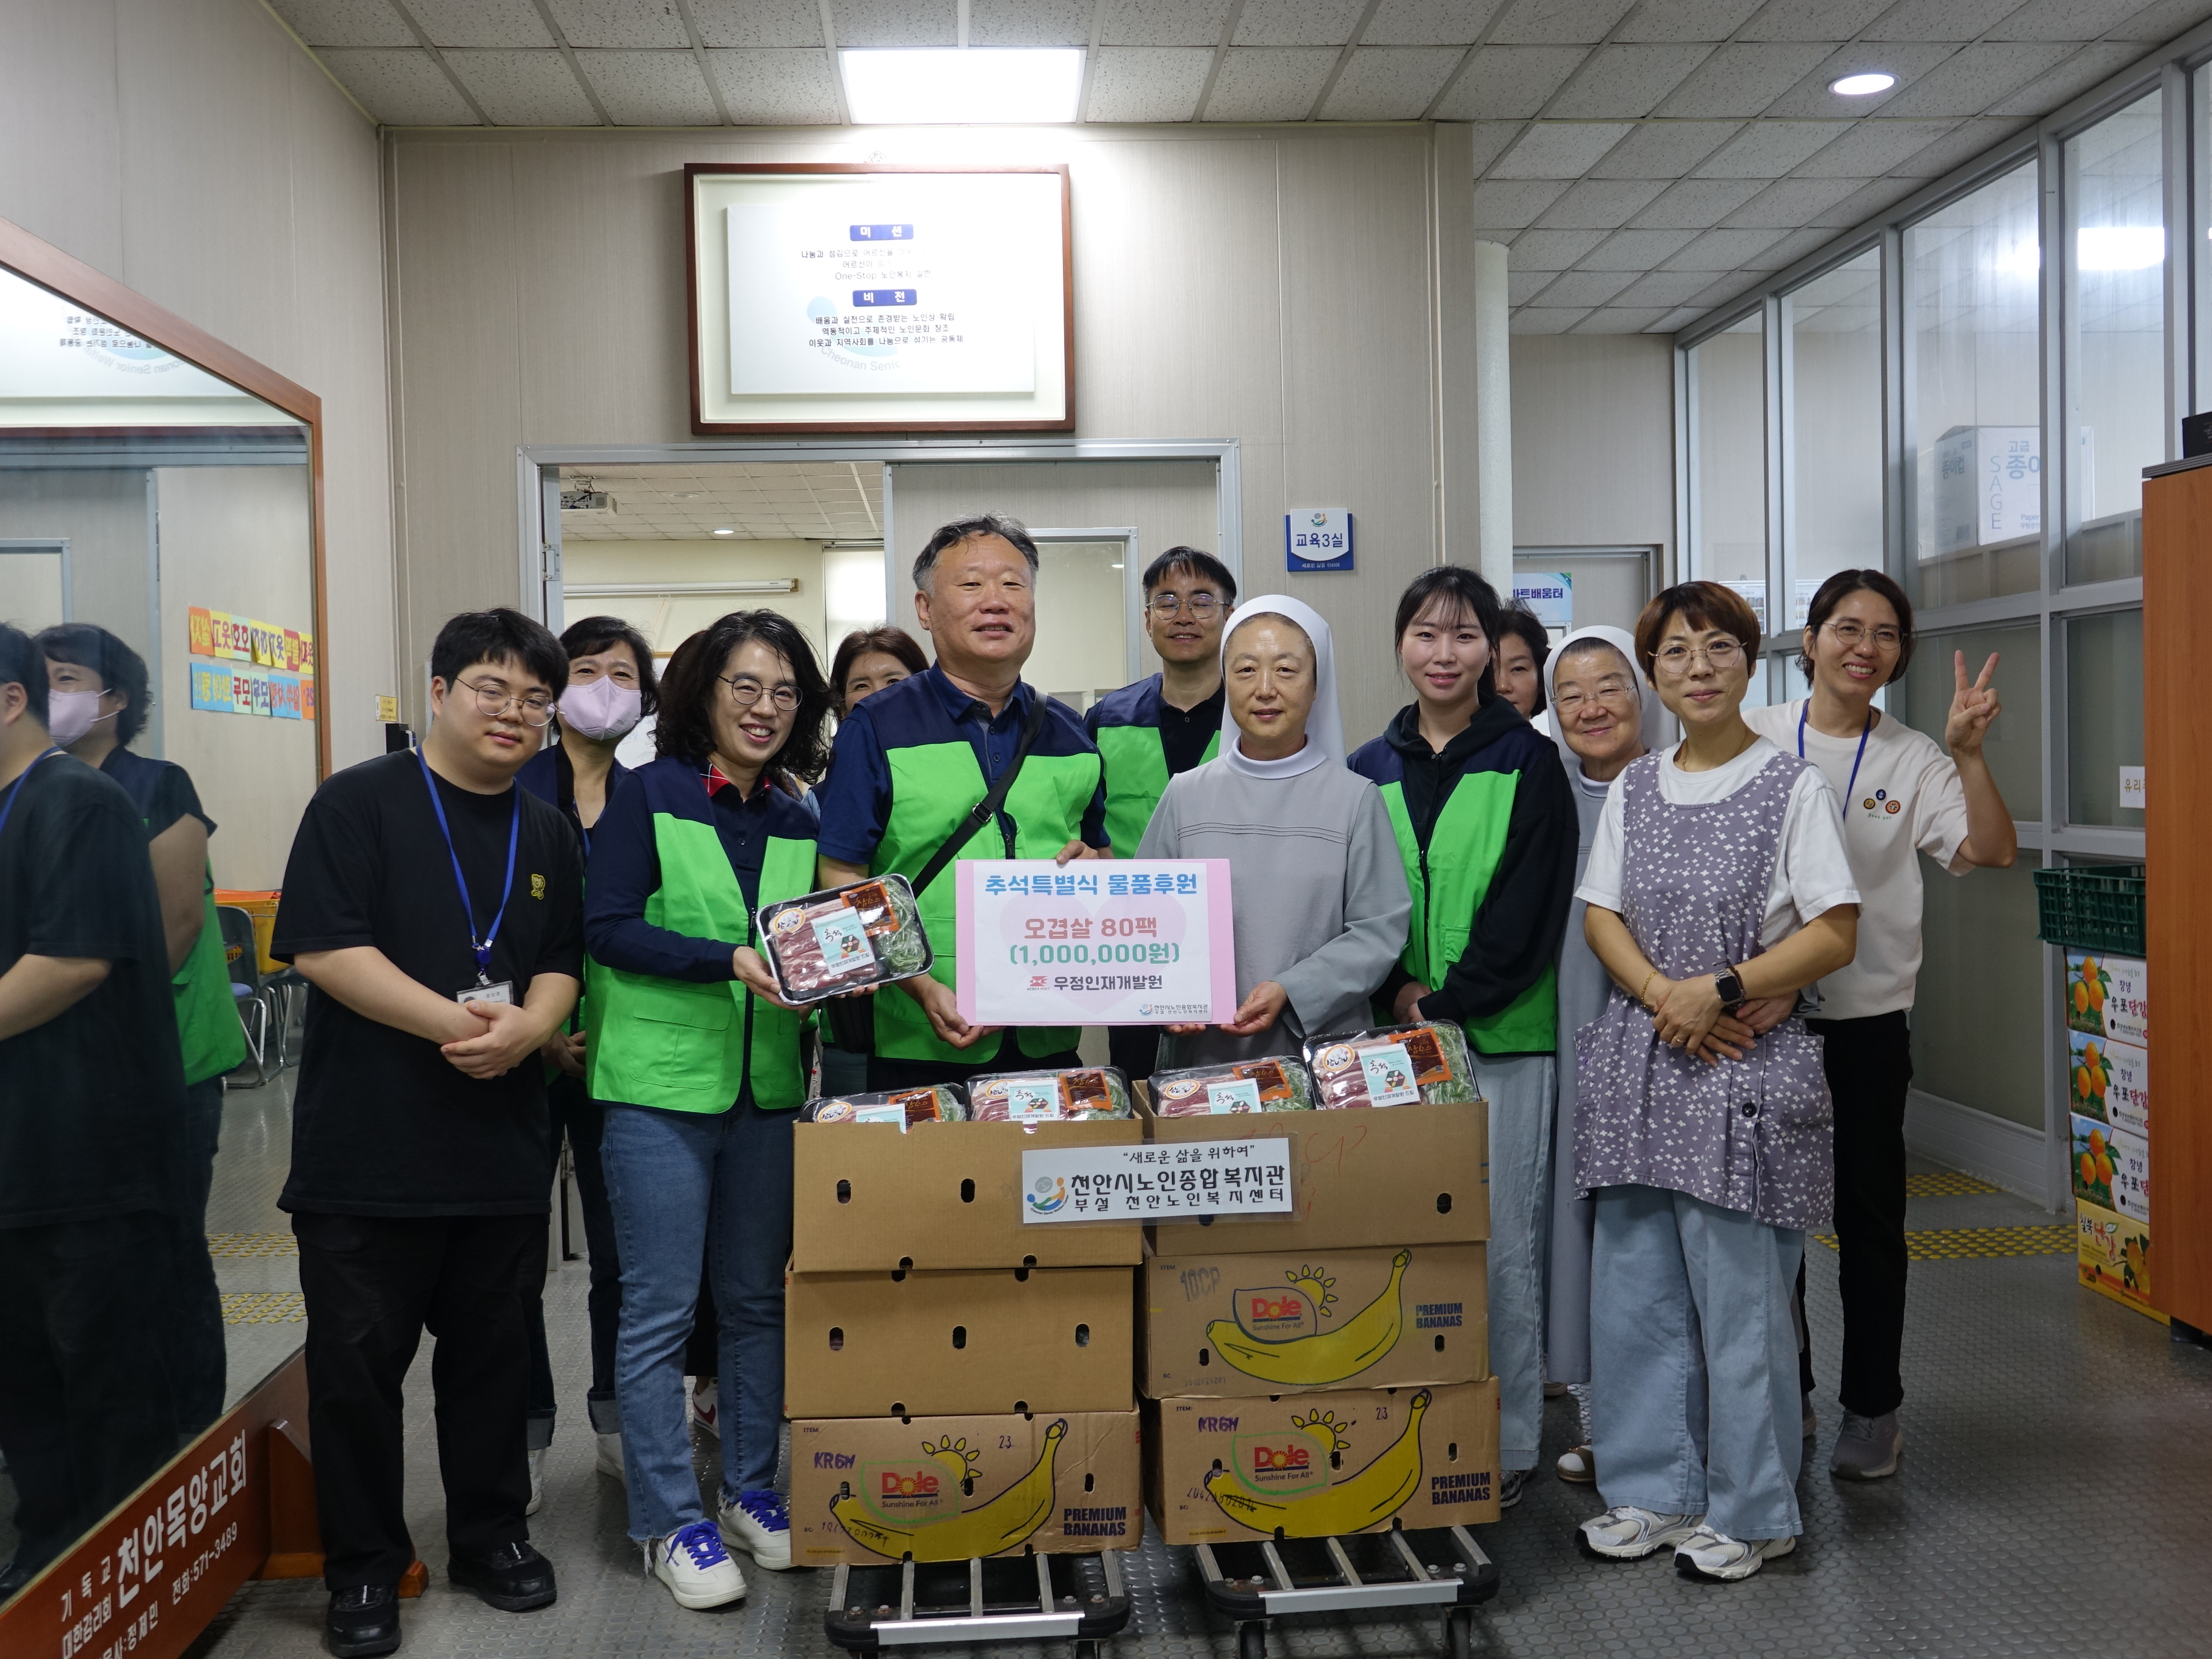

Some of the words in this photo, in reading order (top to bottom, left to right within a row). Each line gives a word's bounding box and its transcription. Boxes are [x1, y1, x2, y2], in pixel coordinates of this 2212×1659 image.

[801, 250, 824, 259] 나눔과
[828, 249, 859, 258] 섬김으로
[863, 248, 893, 257] 어르신을
[835, 272, 877, 281] One-Stop
[881, 270, 912, 279] 노인복지
[815, 315, 839, 325] 배움과
[843, 315, 874, 324] 실천으로
[878, 314, 908, 323] 존경받는
[913, 313, 936, 322] 노인상
[939, 313, 955, 321] 확립
[822, 326, 860, 336] 역동적이고
[865, 326, 896, 335] 주체적인
[900, 325, 930, 333] 노인문화
[934, 324, 950, 333] 창조
[809, 338, 833, 347] 이웃과
[836, 337, 874, 346] 지역사회를
[879, 337, 909, 346] 나눔으로
[940, 335, 964, 343] 공동체
[820, 347, 867, 370] Cheonan
[2008, 440, 2030, 453] 고급
[1989, 456, 2002, 530] SAGE
[1296, 532, 1343, 548] 교육3실
[985, 874, 1098, 896] 추석특별식
[1108, 873, 1197, 896] 물품후원
[1024, 917, 1094, 940] 오겹살
[1101, 917, 1158, 939] 80팩
[1010, 942, 1181, 967] (1,000,000원)
[1053, 975, 1163, 991] 우정인재개발원
[1175, 1148, 1202, 1163] 삶을
[1071, 1165, 1285, 1196] 천안시노인종합복지관
[1074, 1196, 1109, 1212] 부설
[1252, 1296, 1302, 1320] Dole
[1416, 1302, 1463, 1317] PREMIUM
[1416, 1315, 1463, 1329] BANANAS
[1376, 1406, 1389, 1420] 23
[998, 1435, 1013, 1449] 23
[1254, 1444, 1310, 1469] Dole
[882, 1470, 939, 1496] Dole
[1255, 1473, 1287, 1482] Sunshine
[1431, 1472, 1491, 1489] PREMIUM
[1431, 1486, 1491, 1506] BANANAS
[116, 1428, 247, 1610] 천안목양교회
[1063, 1506, 1127, 1523] PREMIUM
[1063, 1521, 1127, 1537] BANANAS
[172, 1520, 238, 1606] 전화:571-3489
[62, 1592, 112, 1659] 대한감리회
